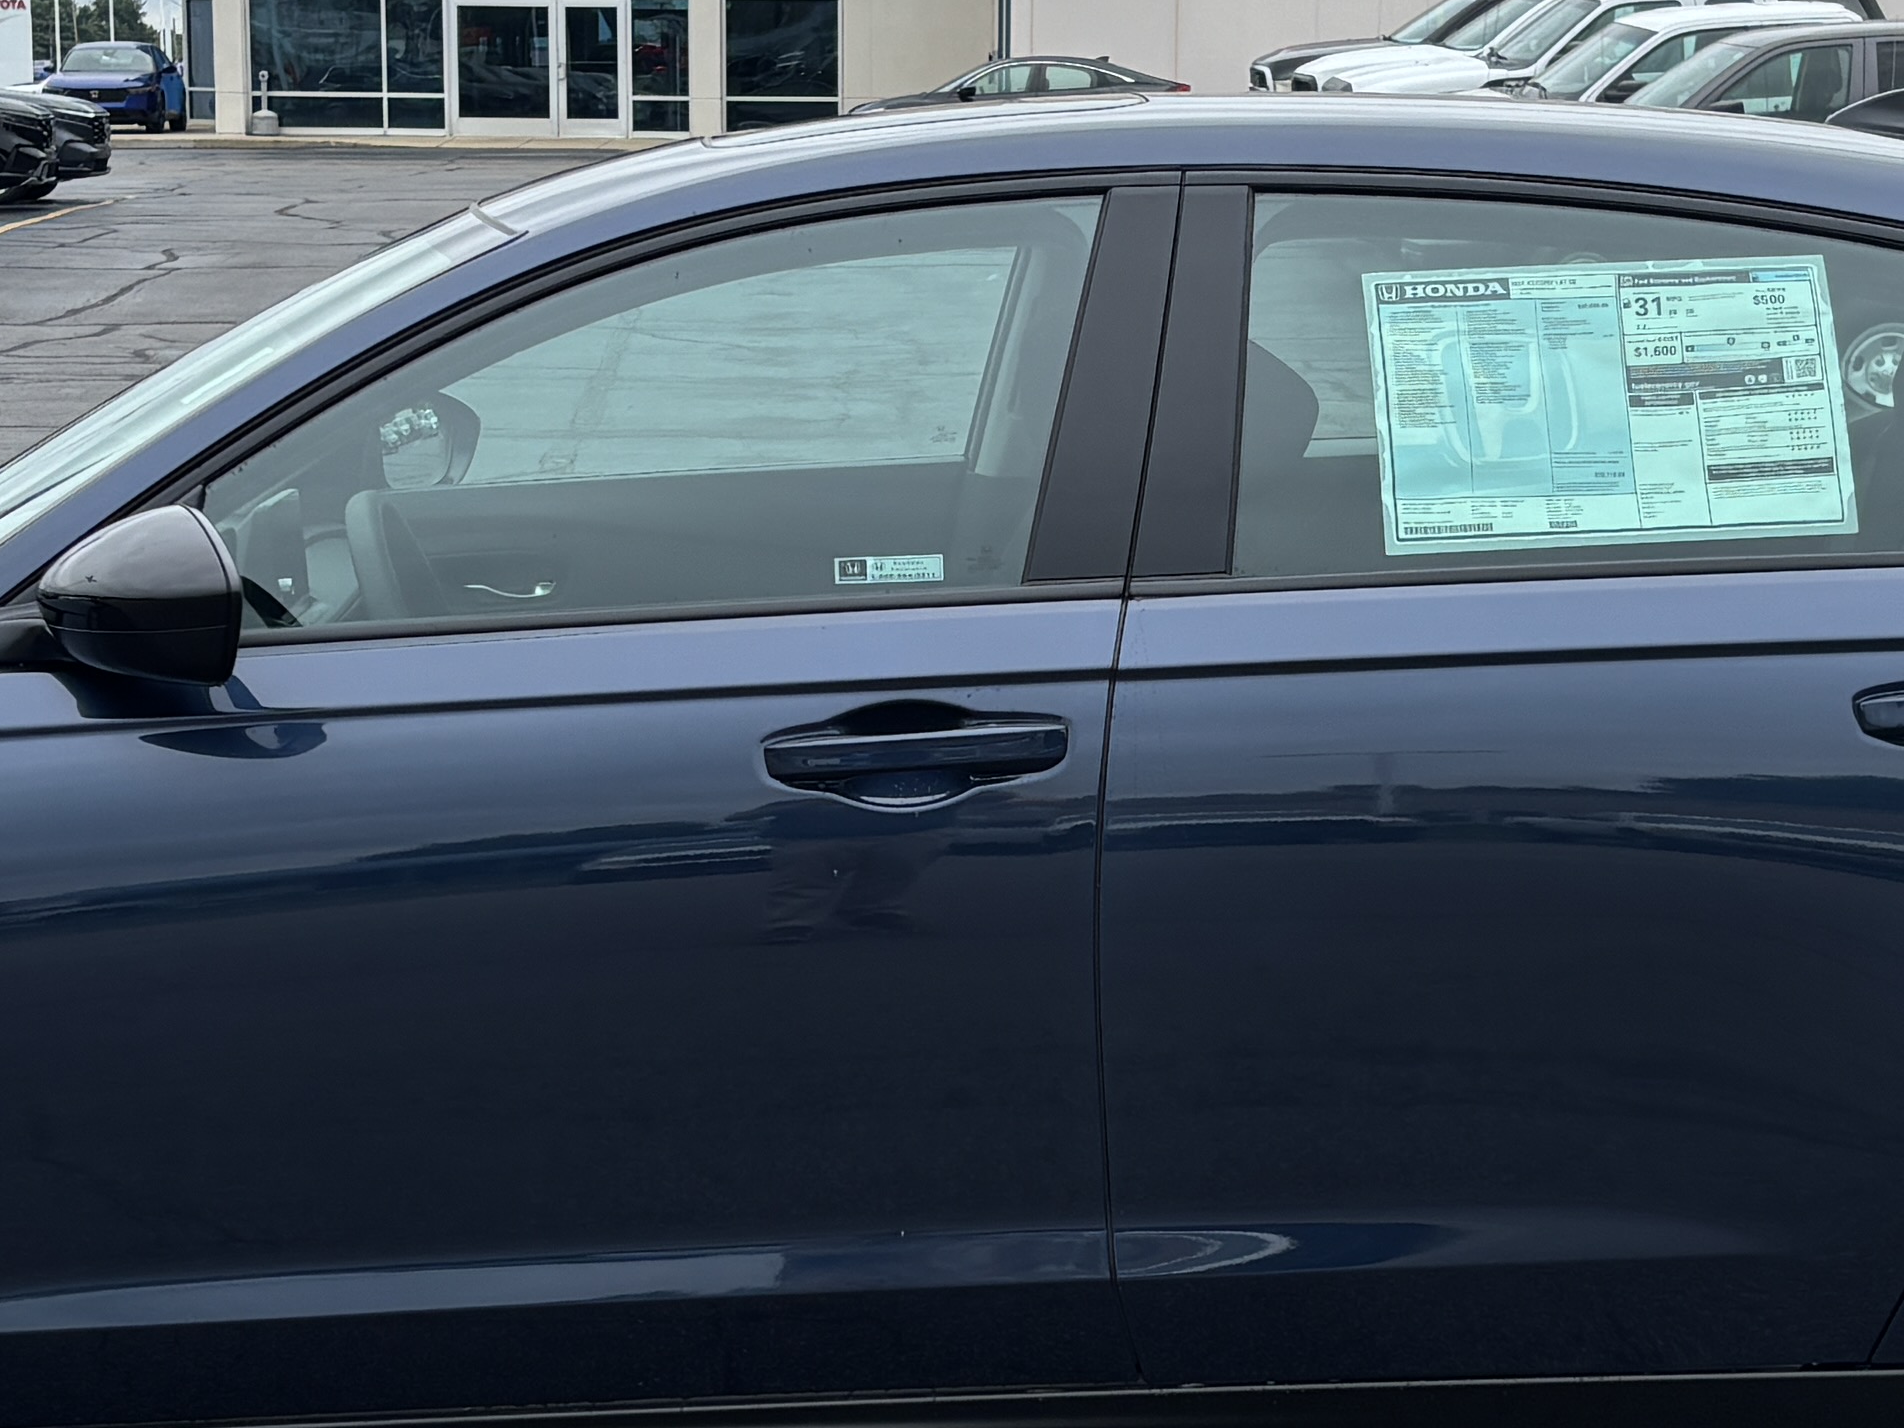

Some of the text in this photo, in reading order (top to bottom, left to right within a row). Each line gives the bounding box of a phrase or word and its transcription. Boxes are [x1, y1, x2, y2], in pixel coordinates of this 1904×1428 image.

[1404, 283, 1507, 298] HONDA
[1634, 296, 1662, 317] 31
[1752, 294, 1785, 306] $500
[1634, 345, 1677, 357] $1,600
